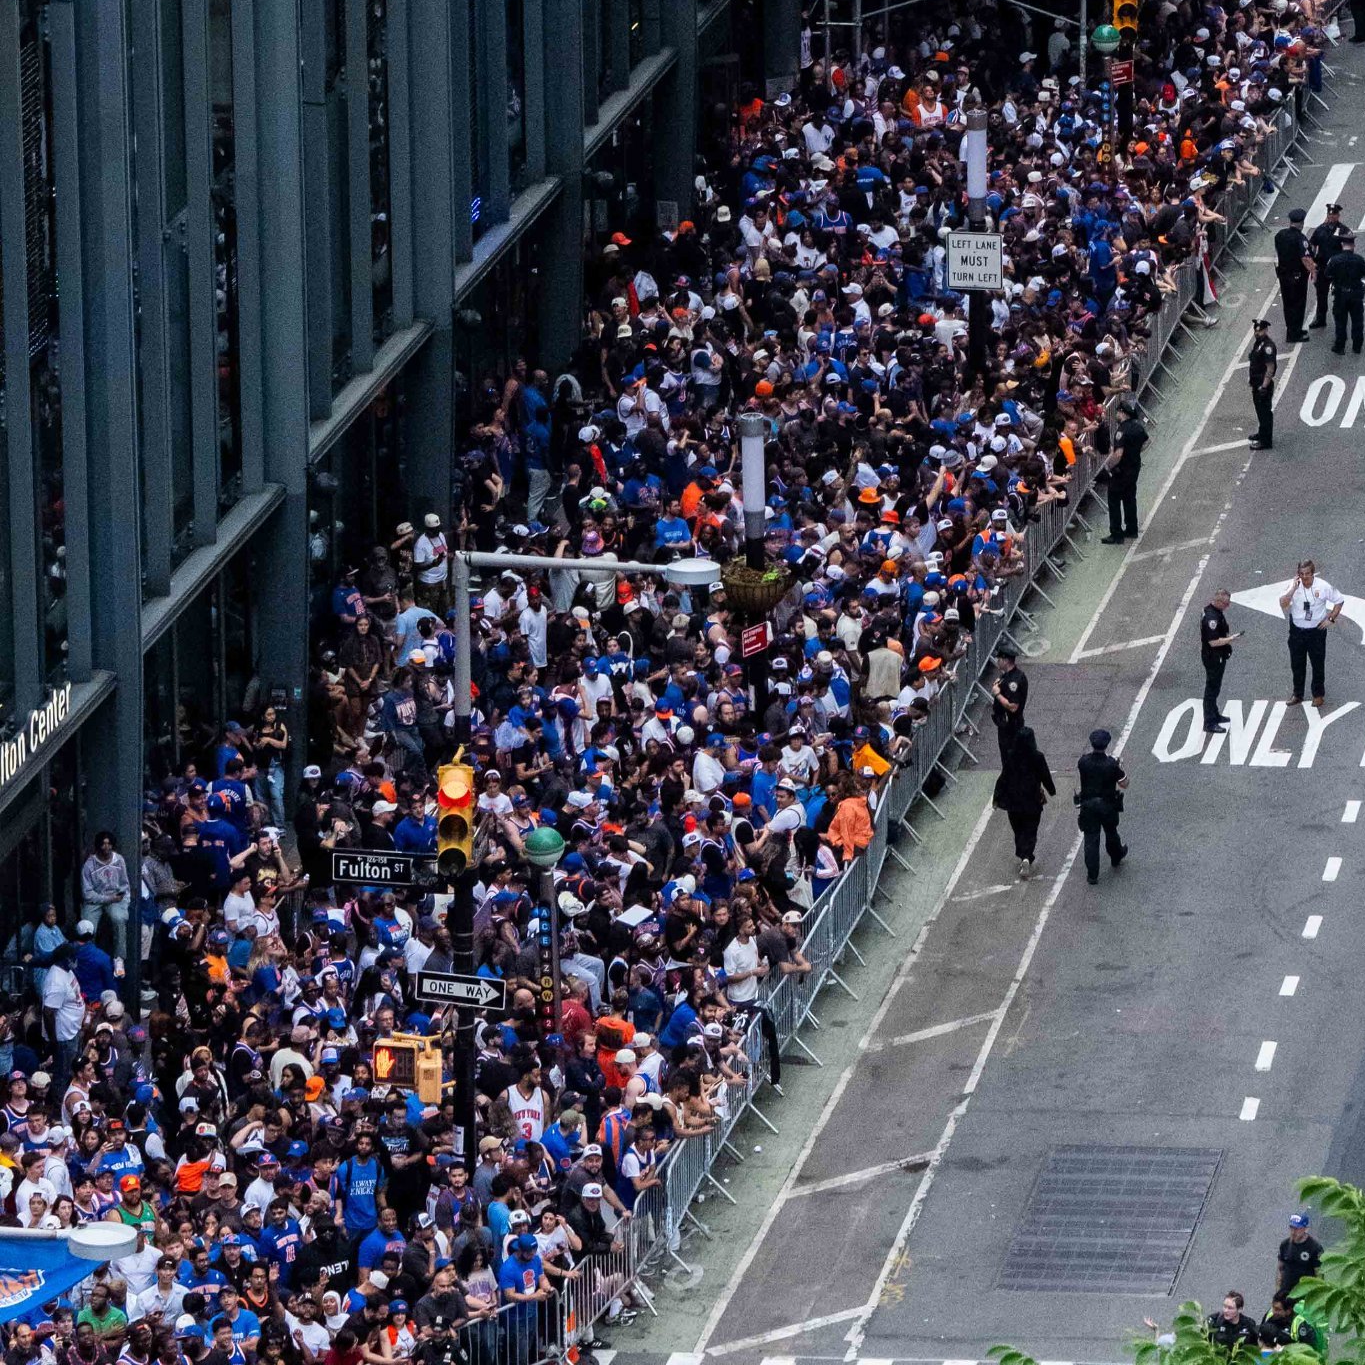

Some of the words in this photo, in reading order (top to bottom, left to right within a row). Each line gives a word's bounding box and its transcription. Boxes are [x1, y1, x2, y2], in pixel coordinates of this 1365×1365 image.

[952, 240, 972, 249] LEFT
[975, 241, 997, 251] LANE
[960, 256, 989, 267] MUST
[952, 271, 974, 282] TURN
[978, 273, 998, 283] LEFT
[30, 681, 71, 753] Center
[1152, 699, 1362, 769] ONLY
[339, 859, 391, 880] Fulton
[394, 863, 404, 873] ST
[429, 981, 454, 995] ONE
[466, 985, 492, 999] WAY
[526, 1109, 541, 1120] YORK
[521, 1122, 533, 1140] 3
[350, 1187, 375, 1196] KNICKS
